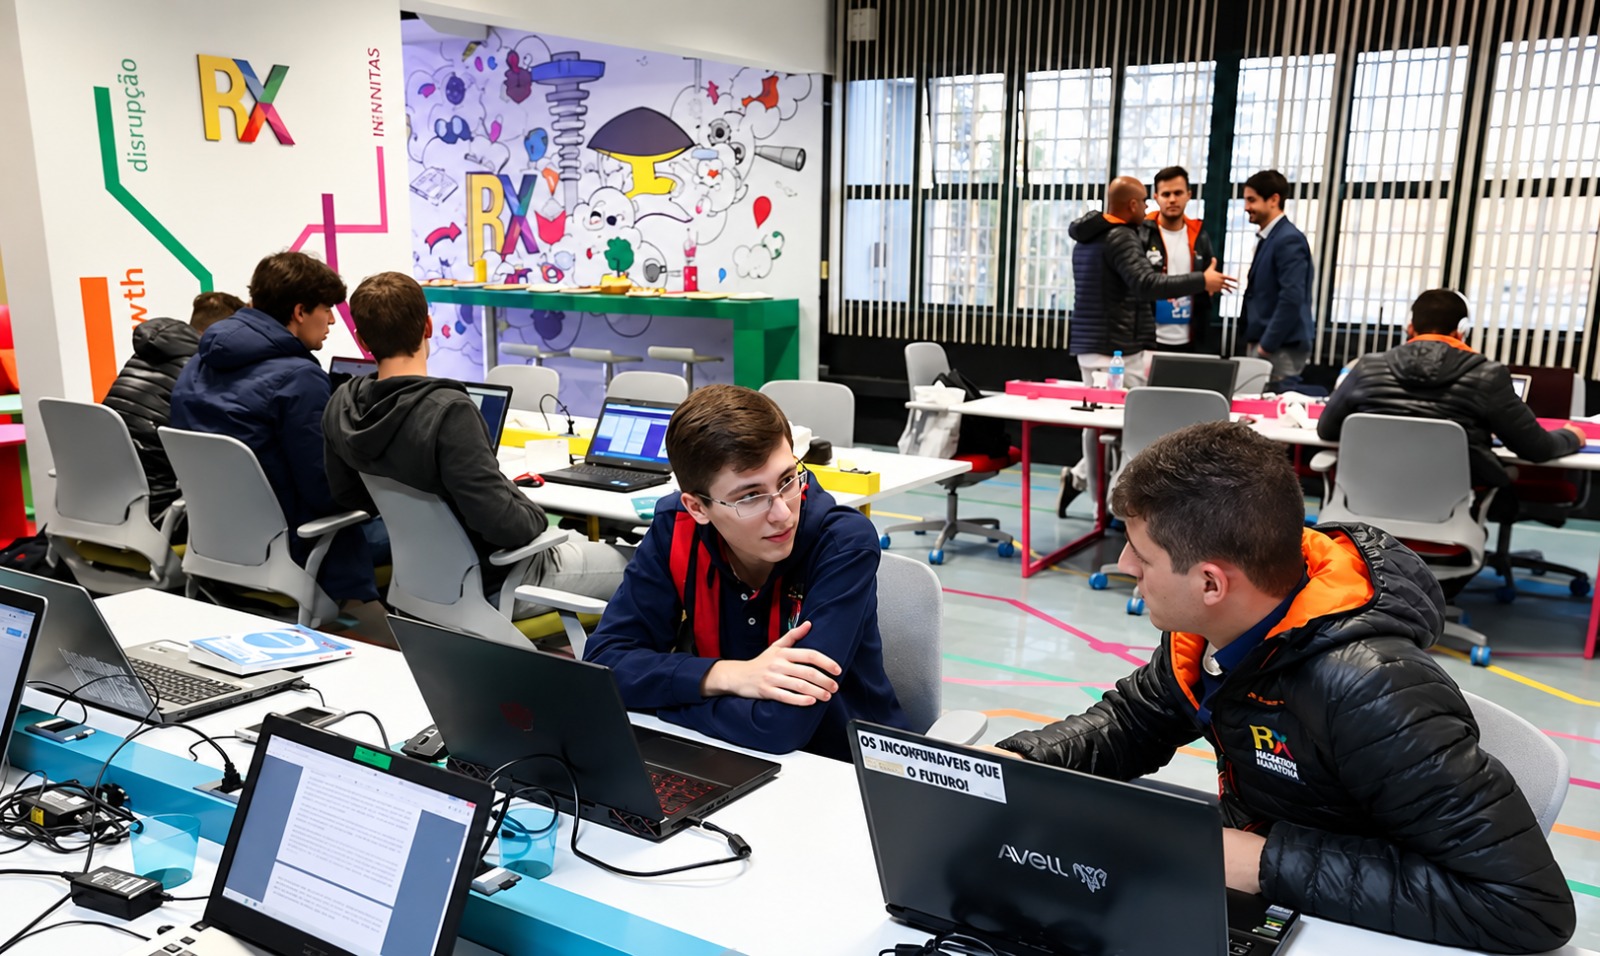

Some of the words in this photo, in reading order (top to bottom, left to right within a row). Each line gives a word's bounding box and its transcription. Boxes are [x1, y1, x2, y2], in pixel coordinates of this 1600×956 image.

[117, 58, 148, 172] disrupção
[196, 54, 296, 145] RX
[465, 171, 541, 267] RX
[860, 735, 876, 750] OS
[974, 762, 1001, 779] QUE
[1249, 724, 1294, 760] RX
[907, 766, 916, 778] O
[919, 769, 970, 791] FUTURO!
